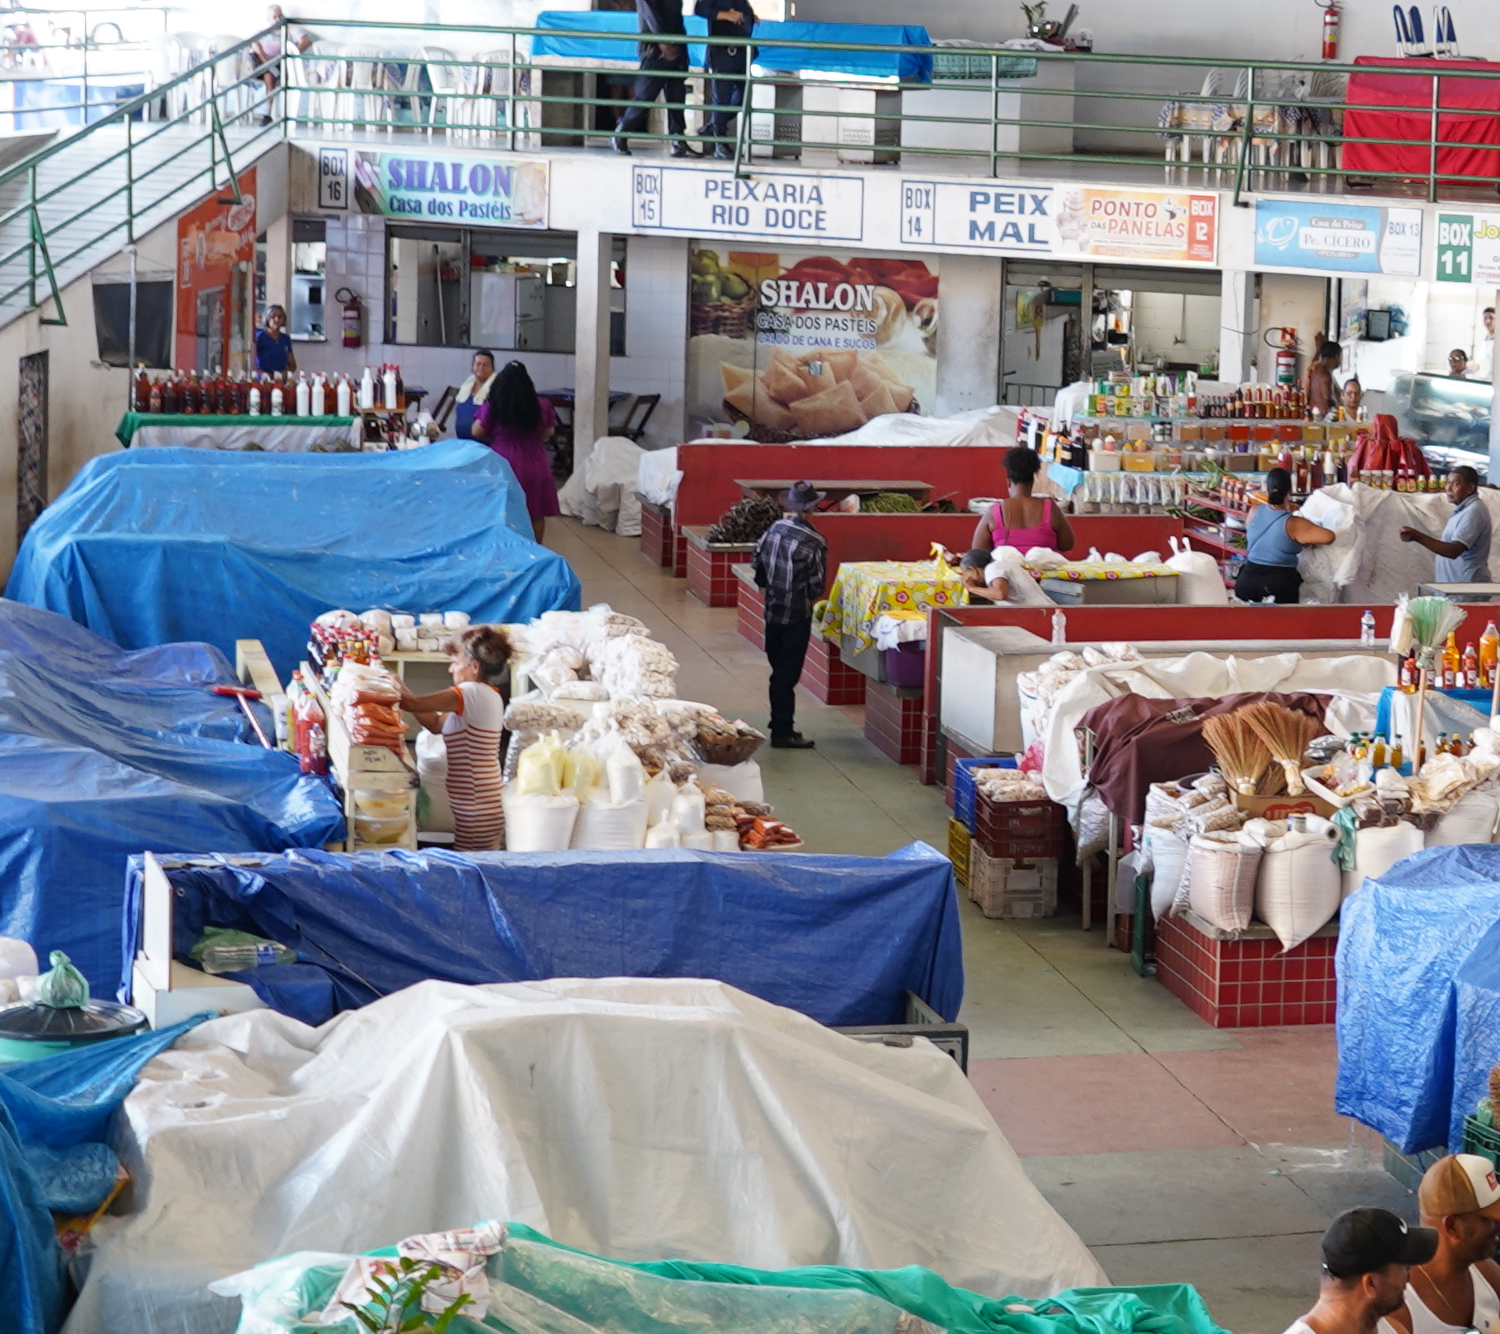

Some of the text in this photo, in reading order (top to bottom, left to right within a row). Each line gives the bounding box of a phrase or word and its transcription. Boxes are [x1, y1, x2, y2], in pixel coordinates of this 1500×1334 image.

[323, 156, 346, 178] BOX
[387, 159, 515, 198] SHALON
[635, 172, 660, 195] BOX
[327, 180, 342, 200] 16
[704, 178, 824, 205] PEIXARIA
[905, 187, 931, 210] BOX
[388, 195, 425, 216] Casa
[428, 197, 453, 217] dos
[640, 199, 655, 221] 15
[969, 191, 1049, 216] PEIX
[1090, 198, 1158, 218] PONTO
[1190, 198, 1214, 217] BOX
[712, 205, 827, 231] RIO DOCE
[907, 217, 923, 238] 14
[1090, 218, 1186, 239] DAS PANELAS
[1311, 217, 1330, 228] Casa
[1388, 221, 1420, 237] BOX 13
[969, 220, 1049, 245] MAL
[1194, 221, 1209, 242] 12
[1304, 230, 1371, 249] Pe. CÍCERO
[1439, 222, 1471, 248] BOX
[1441, 250, 1468, 276] 11
[760, 278, 876, 312] SHALON
[757, 312, 792, 330] CASA
[795, 315, 821, 332] DOS
[792, 334, 804, 347] DE
[807, 335, 832, 348] CANA
[843, 337, 877, 350] SUCOS
